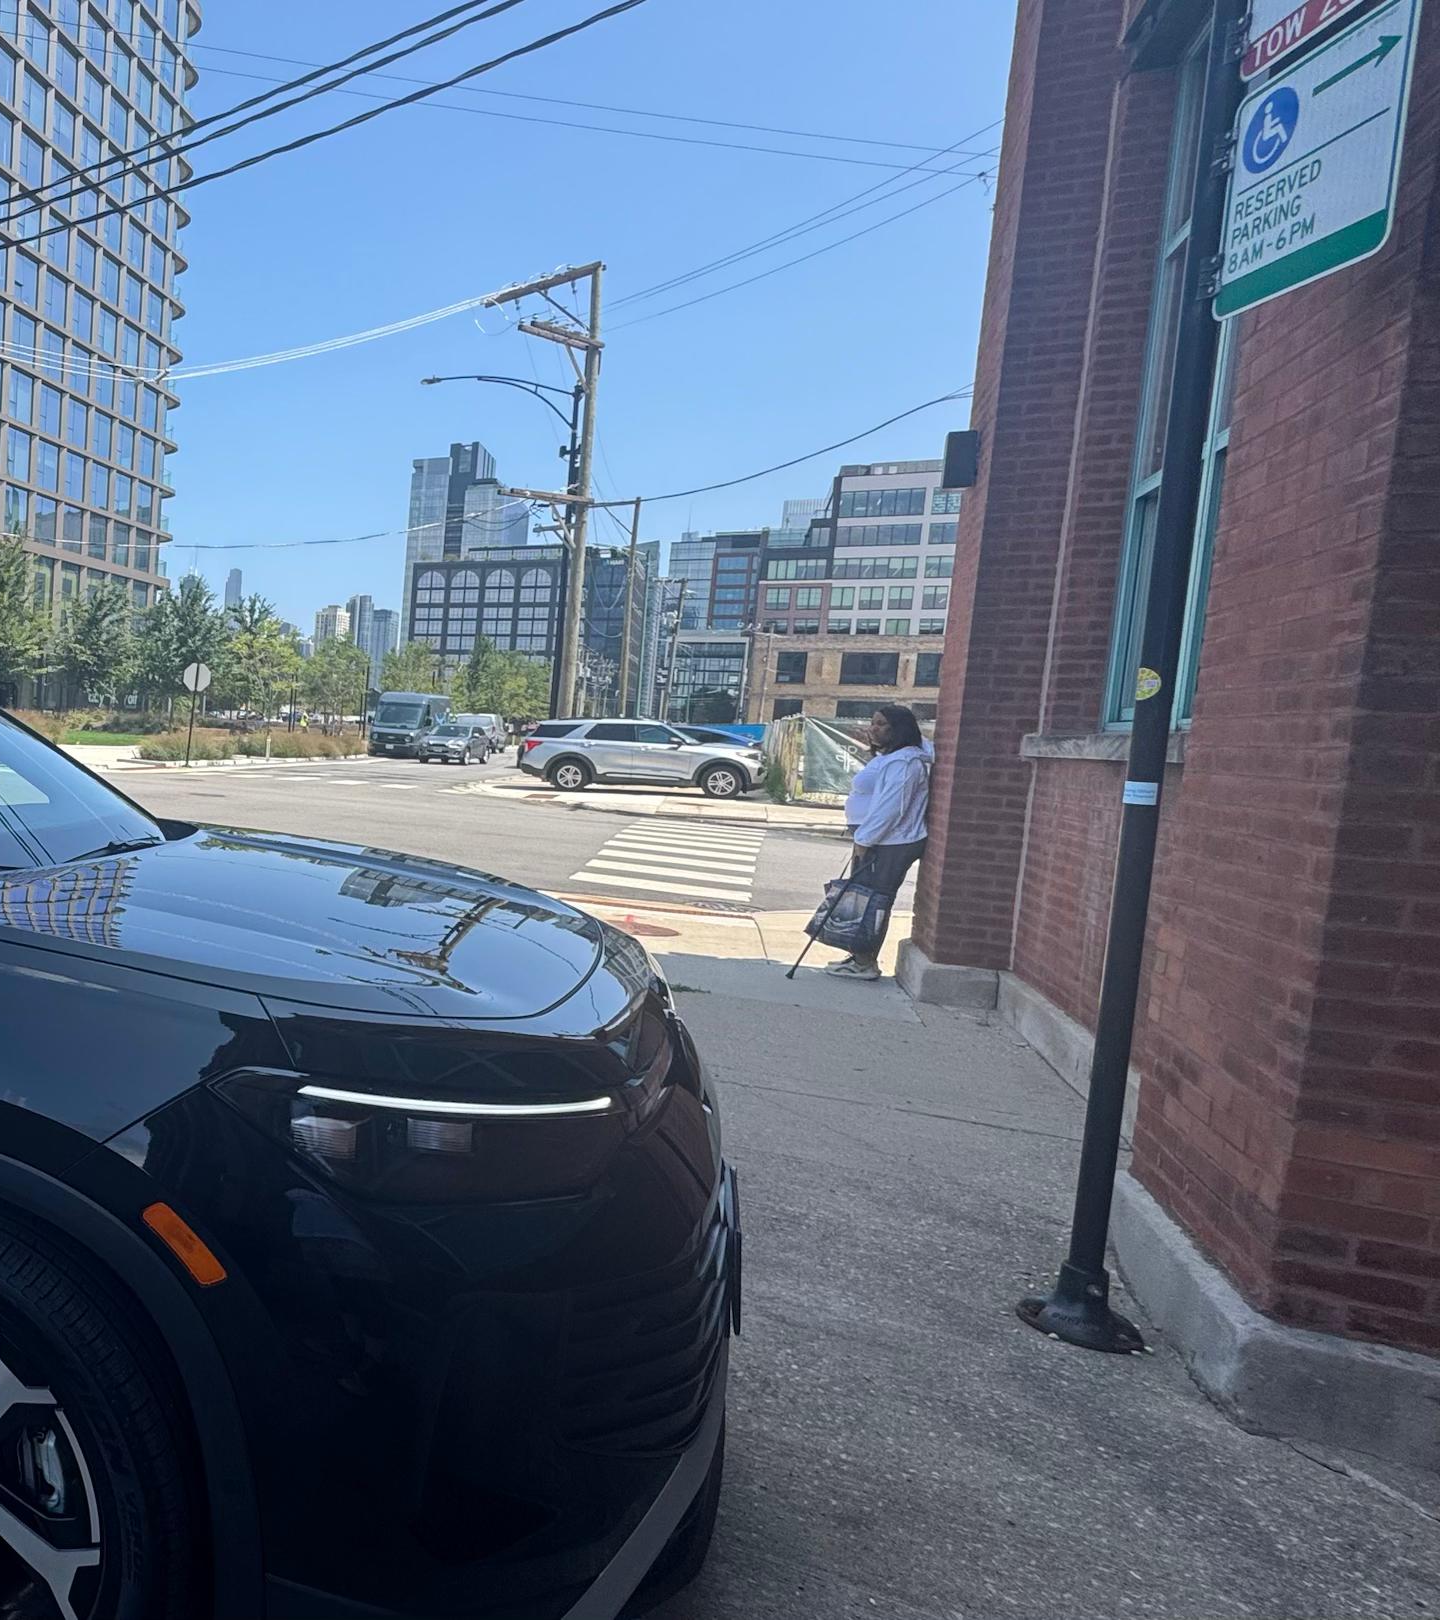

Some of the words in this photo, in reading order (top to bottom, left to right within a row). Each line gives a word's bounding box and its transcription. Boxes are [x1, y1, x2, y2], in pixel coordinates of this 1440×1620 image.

[1252, 7, 1307, 67] TOW
[1234, 159, 1322, 223] RESERVED
[1230, 195, 1302, 249] PARKING
